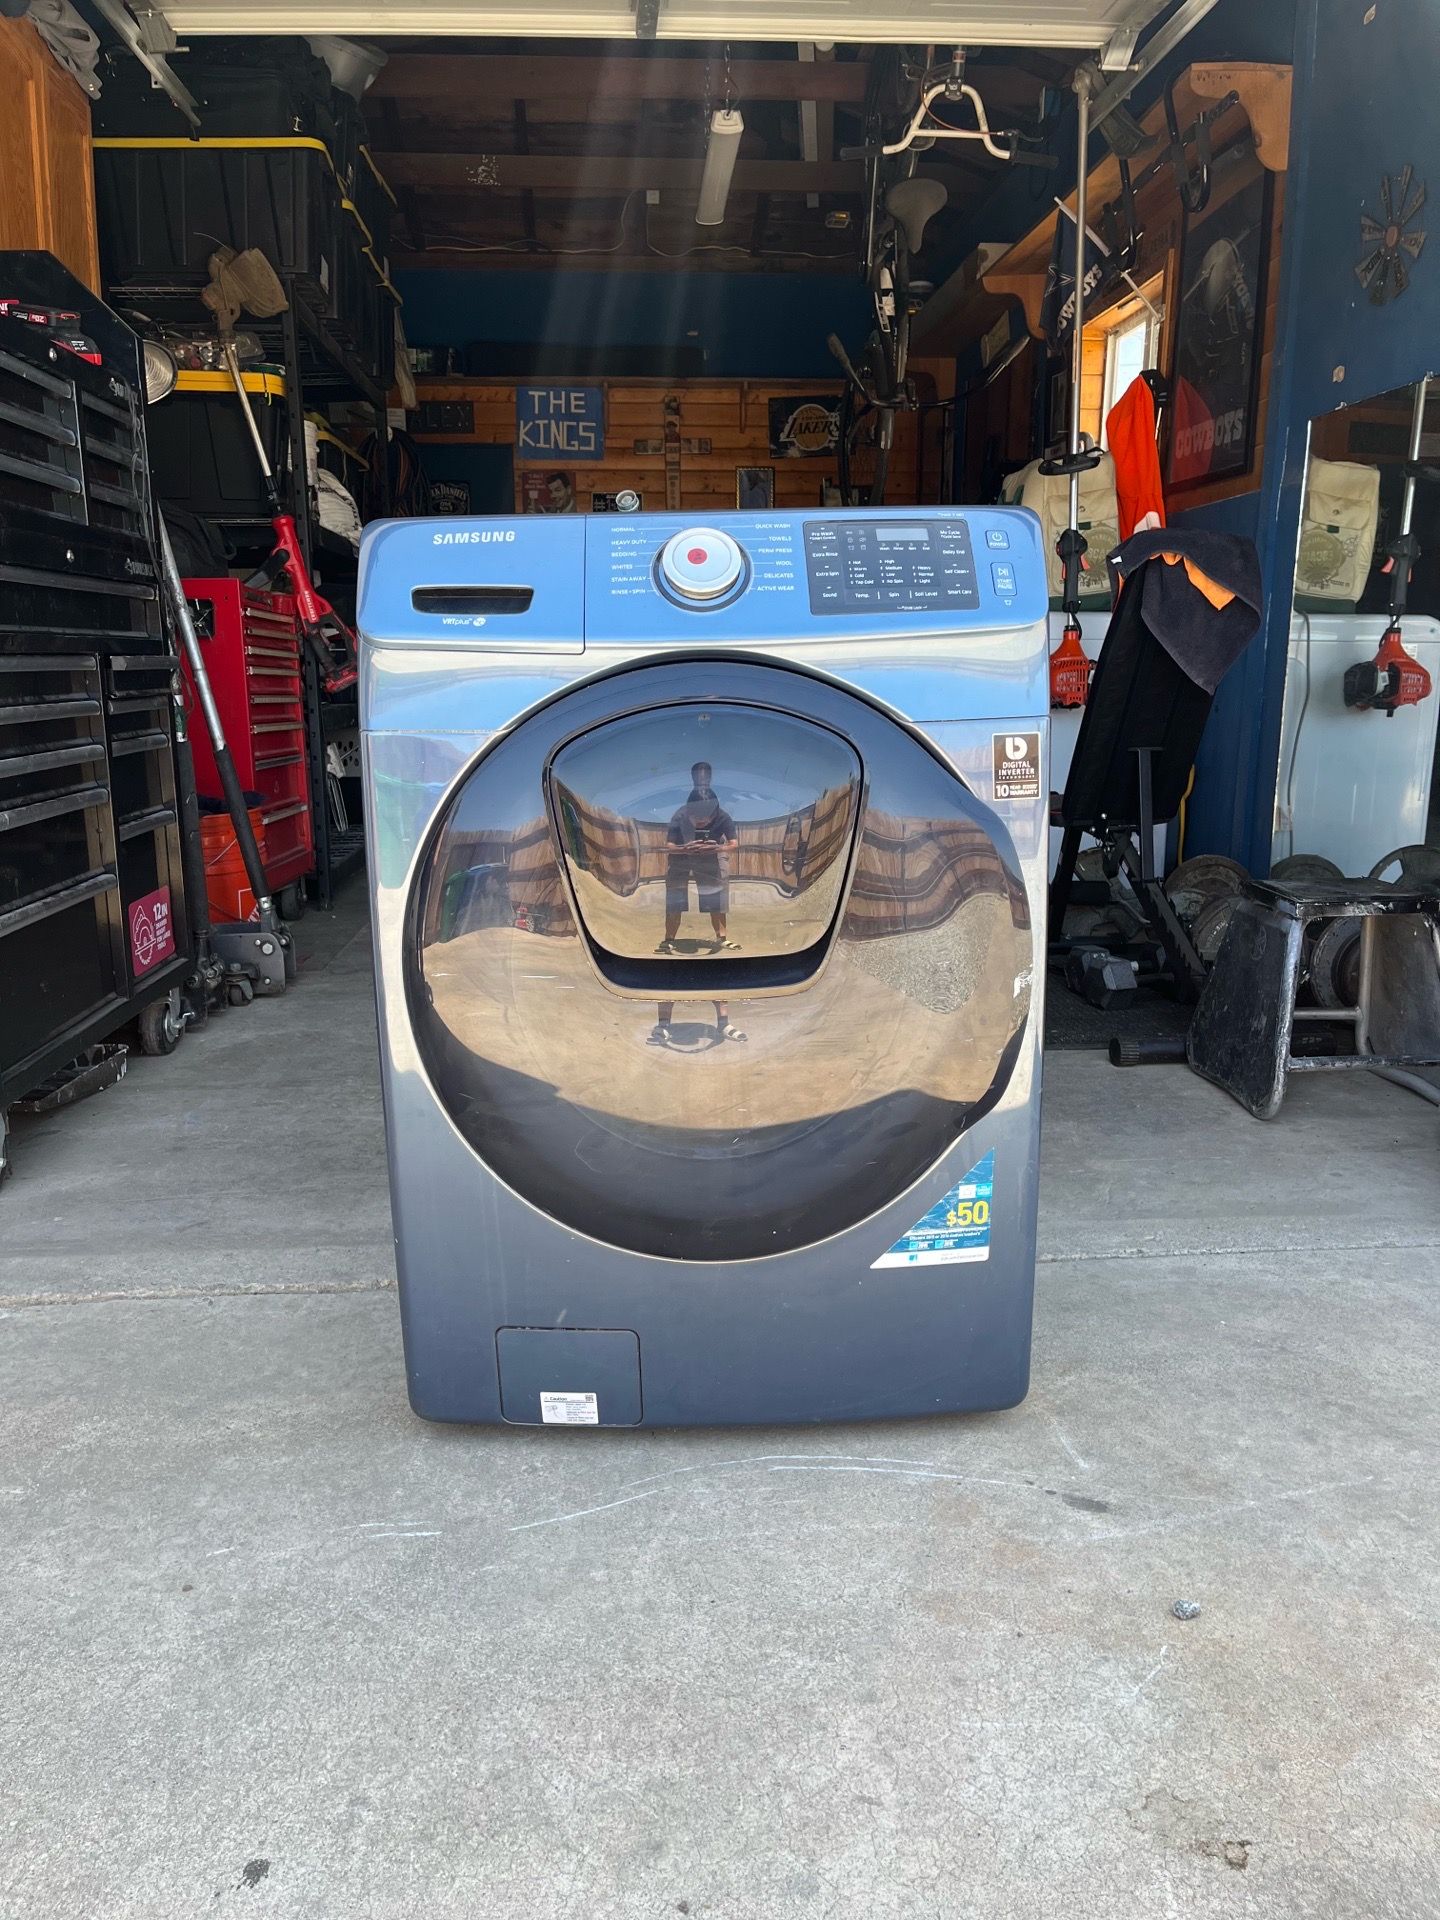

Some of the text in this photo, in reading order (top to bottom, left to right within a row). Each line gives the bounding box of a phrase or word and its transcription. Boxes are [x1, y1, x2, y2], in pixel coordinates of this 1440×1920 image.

[528, 391, 586, 414] THE
[519, 419, 596, 451] KINGS
[785, 414, 840, 439] LAKERS
[1175, 408, 1244, 459] COWBOYS
[432, 530, 516, 545] SAMSUNG
[998, 768, 1035, 776] INVERTER
[1002, 761, 1031, 769] DIGITAL
[995, 784, 1010, 797] 10
[946, 1200, 990, 1227] $50
